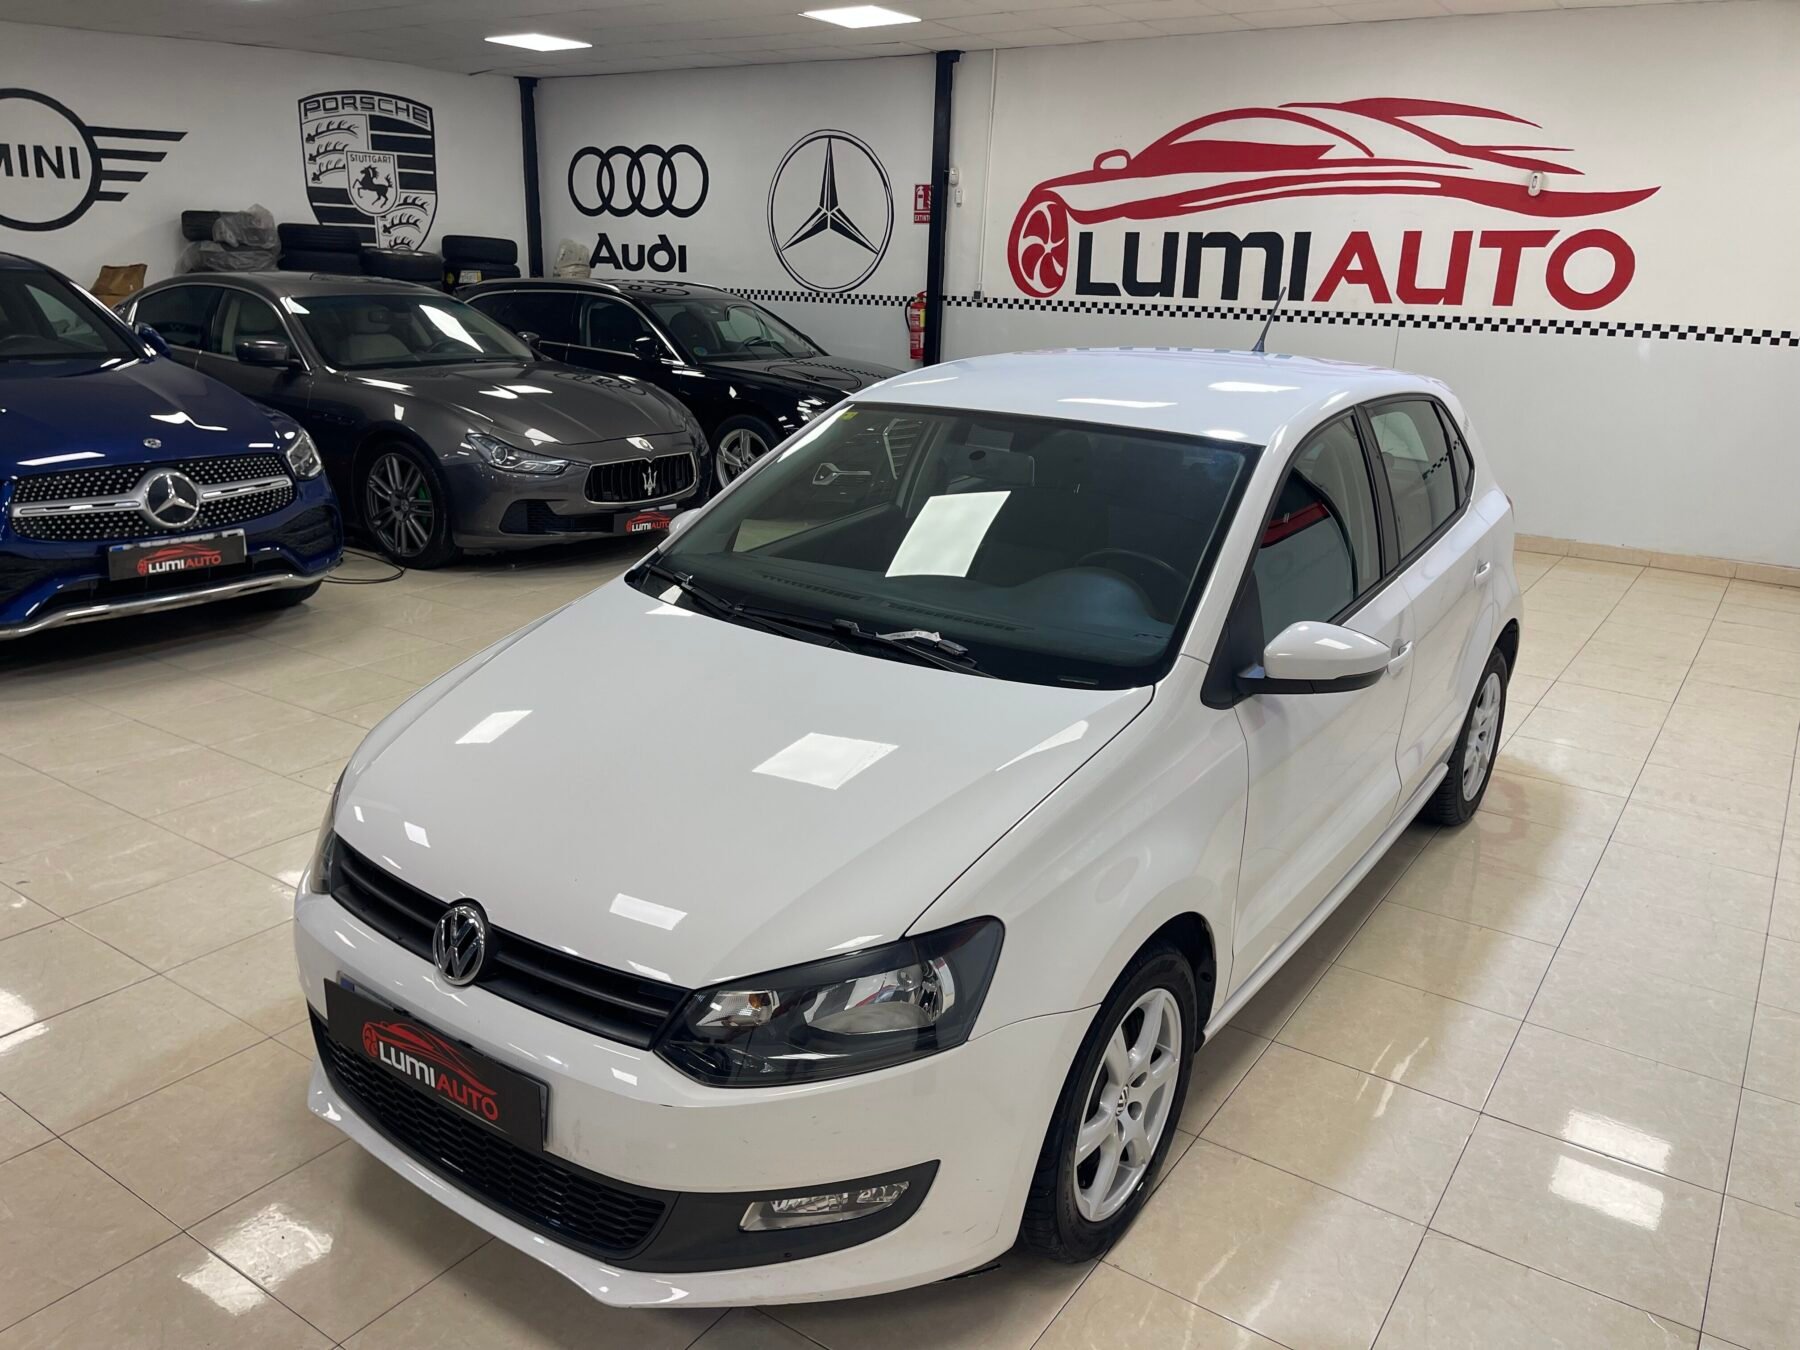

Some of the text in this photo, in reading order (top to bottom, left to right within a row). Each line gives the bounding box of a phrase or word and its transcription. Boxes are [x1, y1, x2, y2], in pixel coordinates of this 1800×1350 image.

[303, 96, 429, 127] PORSCHE
[349, 153, 392, 164] STUTTGART
[589, 233, 687, 273] Audi
